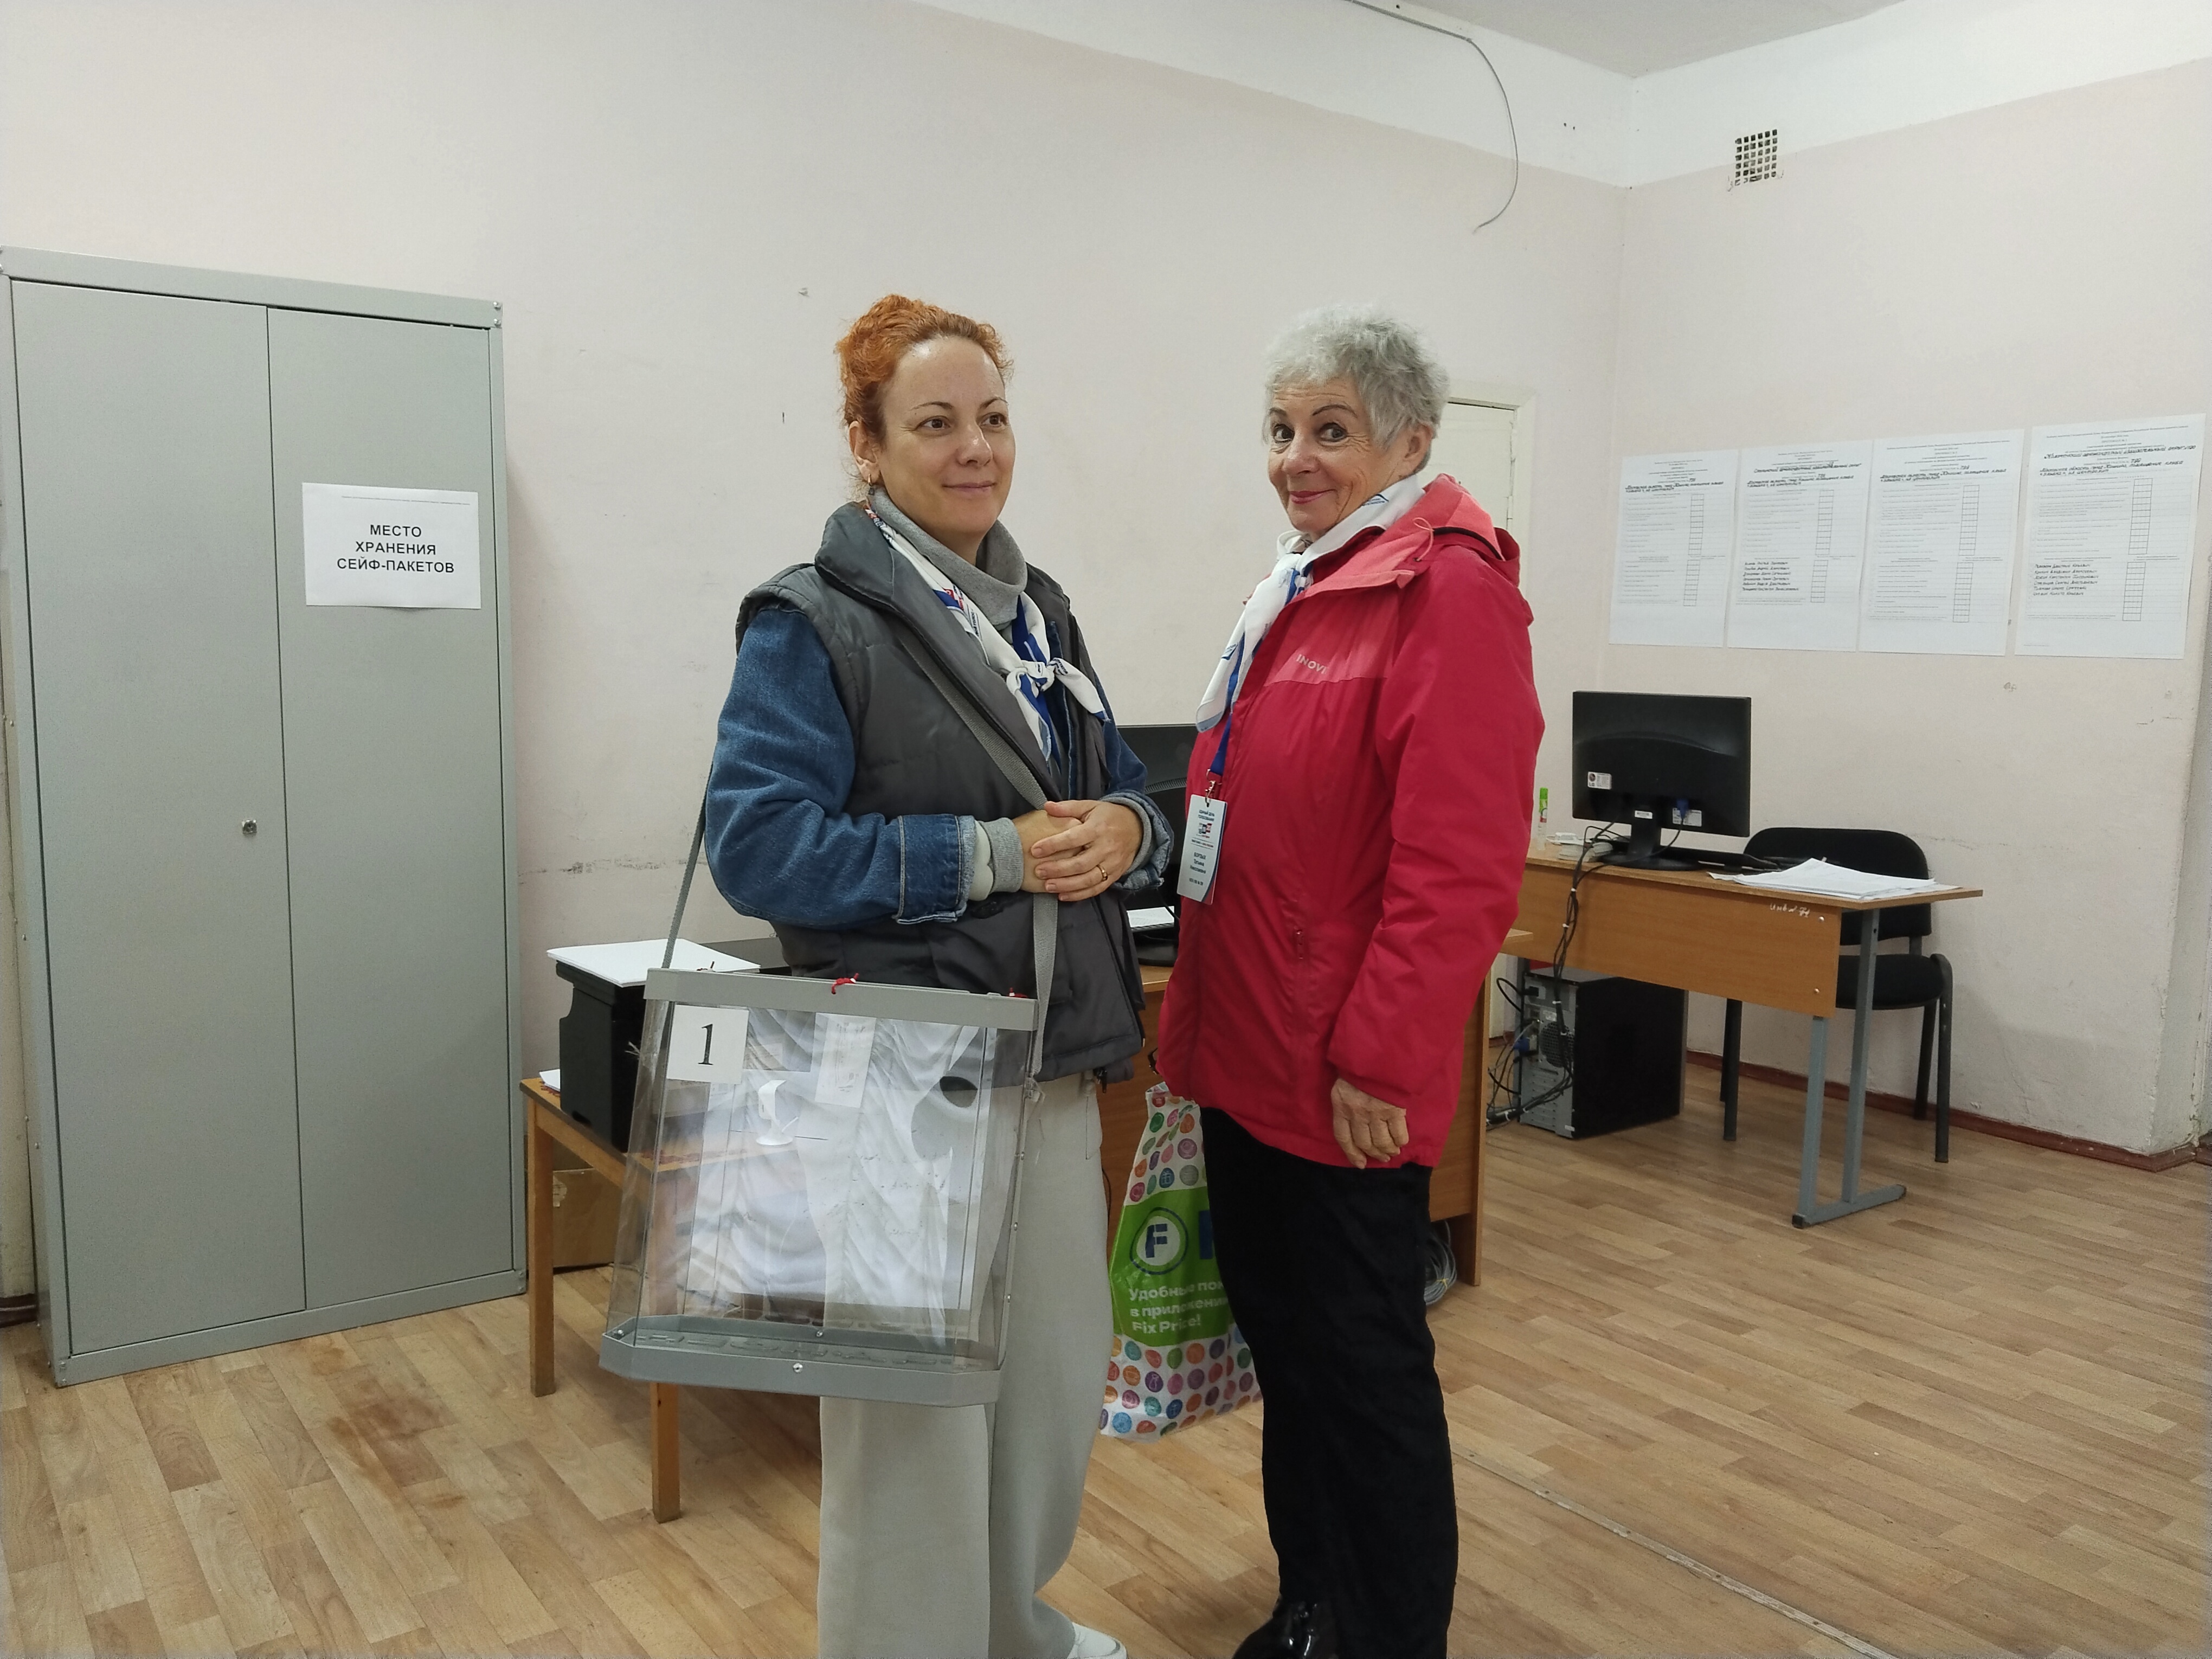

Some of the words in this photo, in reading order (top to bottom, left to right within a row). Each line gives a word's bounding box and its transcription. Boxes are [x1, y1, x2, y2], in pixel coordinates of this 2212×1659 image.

[370, 524, 422, 537] МЕСТО
[356, 541, 436, 555] ХРАНЕНИЯ
[337, 556, 454, 573] СЕЙФ-ПАКЕТОВ
[697, 1023, 714, 1066] 1
[1129, 1308, 1140, 1317] в
[1131, 1321, 1157, 1334] Fix
